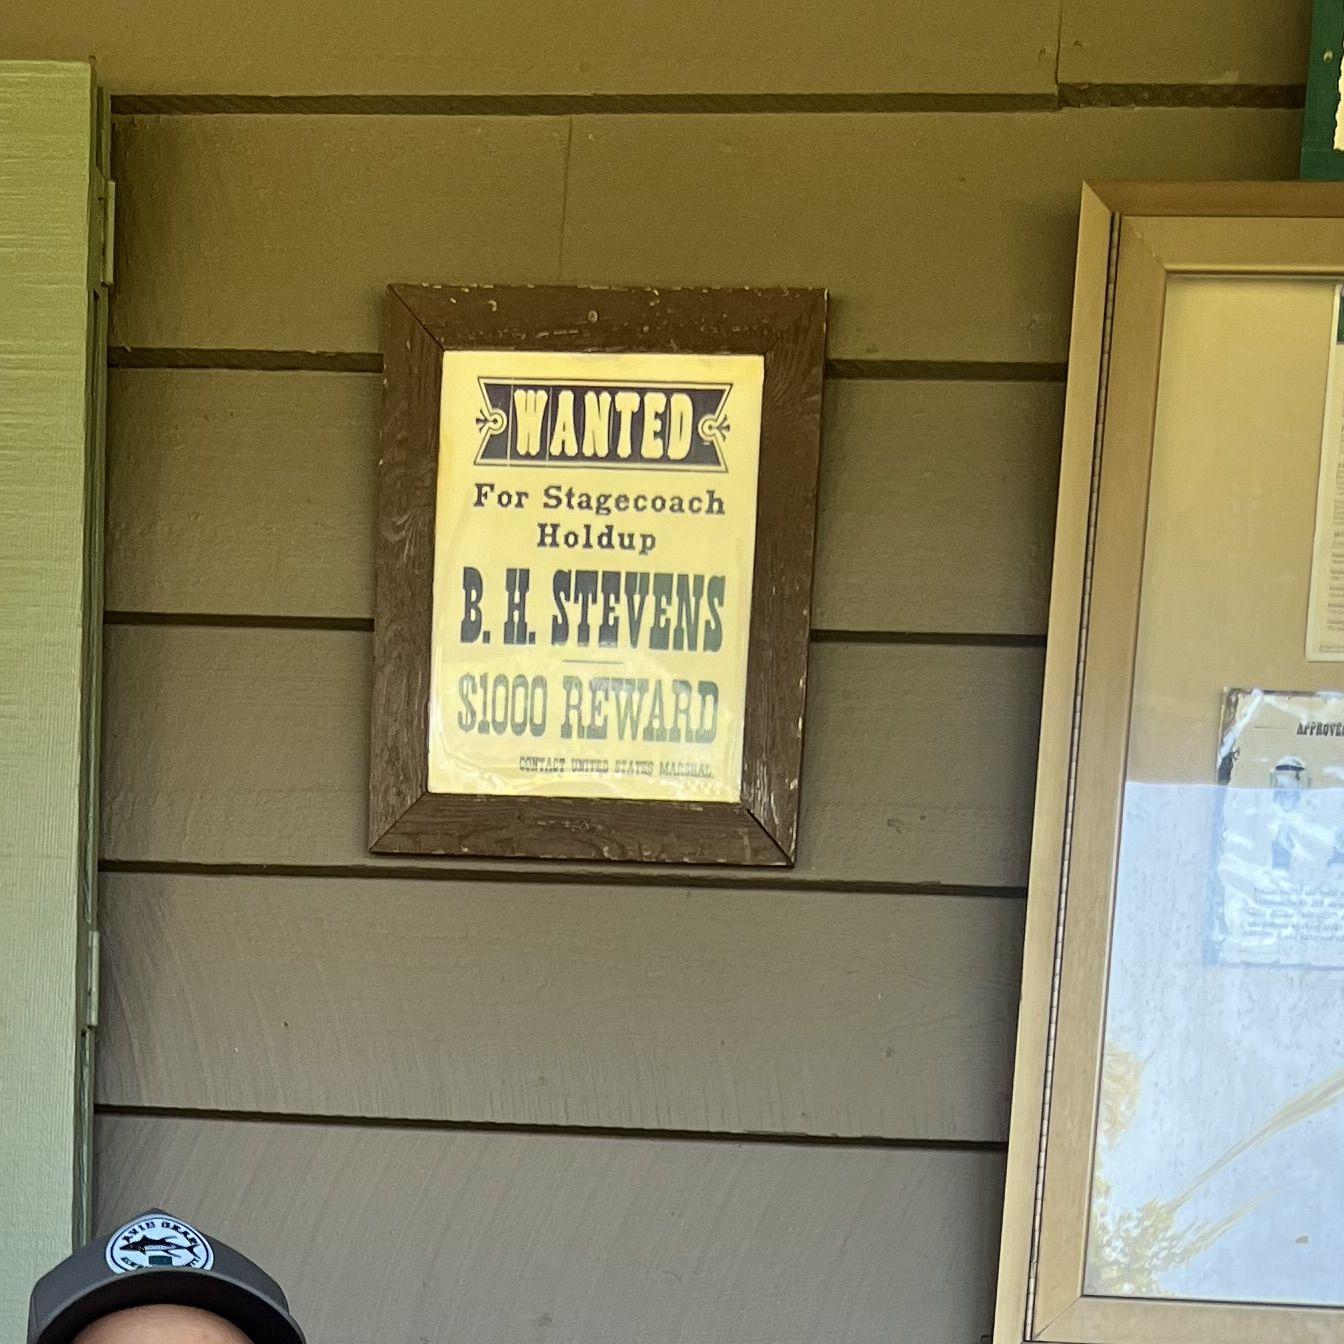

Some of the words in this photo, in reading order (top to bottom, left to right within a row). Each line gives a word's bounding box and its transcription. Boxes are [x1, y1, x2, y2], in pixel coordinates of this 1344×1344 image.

[512, 388, 695, 461] WANTED
[472, 482, 530, 509] For
[542, 484, 727, 516] Stagecoach
[536, 523, 657, 555] Holdup
[459, 565, 491, 645] B.
[503, 566, 537, 646] H.
[550, 568, 728, 653] STEVENS
[457, 672, 549, 738] $1000
[560, 675, 720, 745] REWARD
[519, 755, 566, 773] CONTACT
